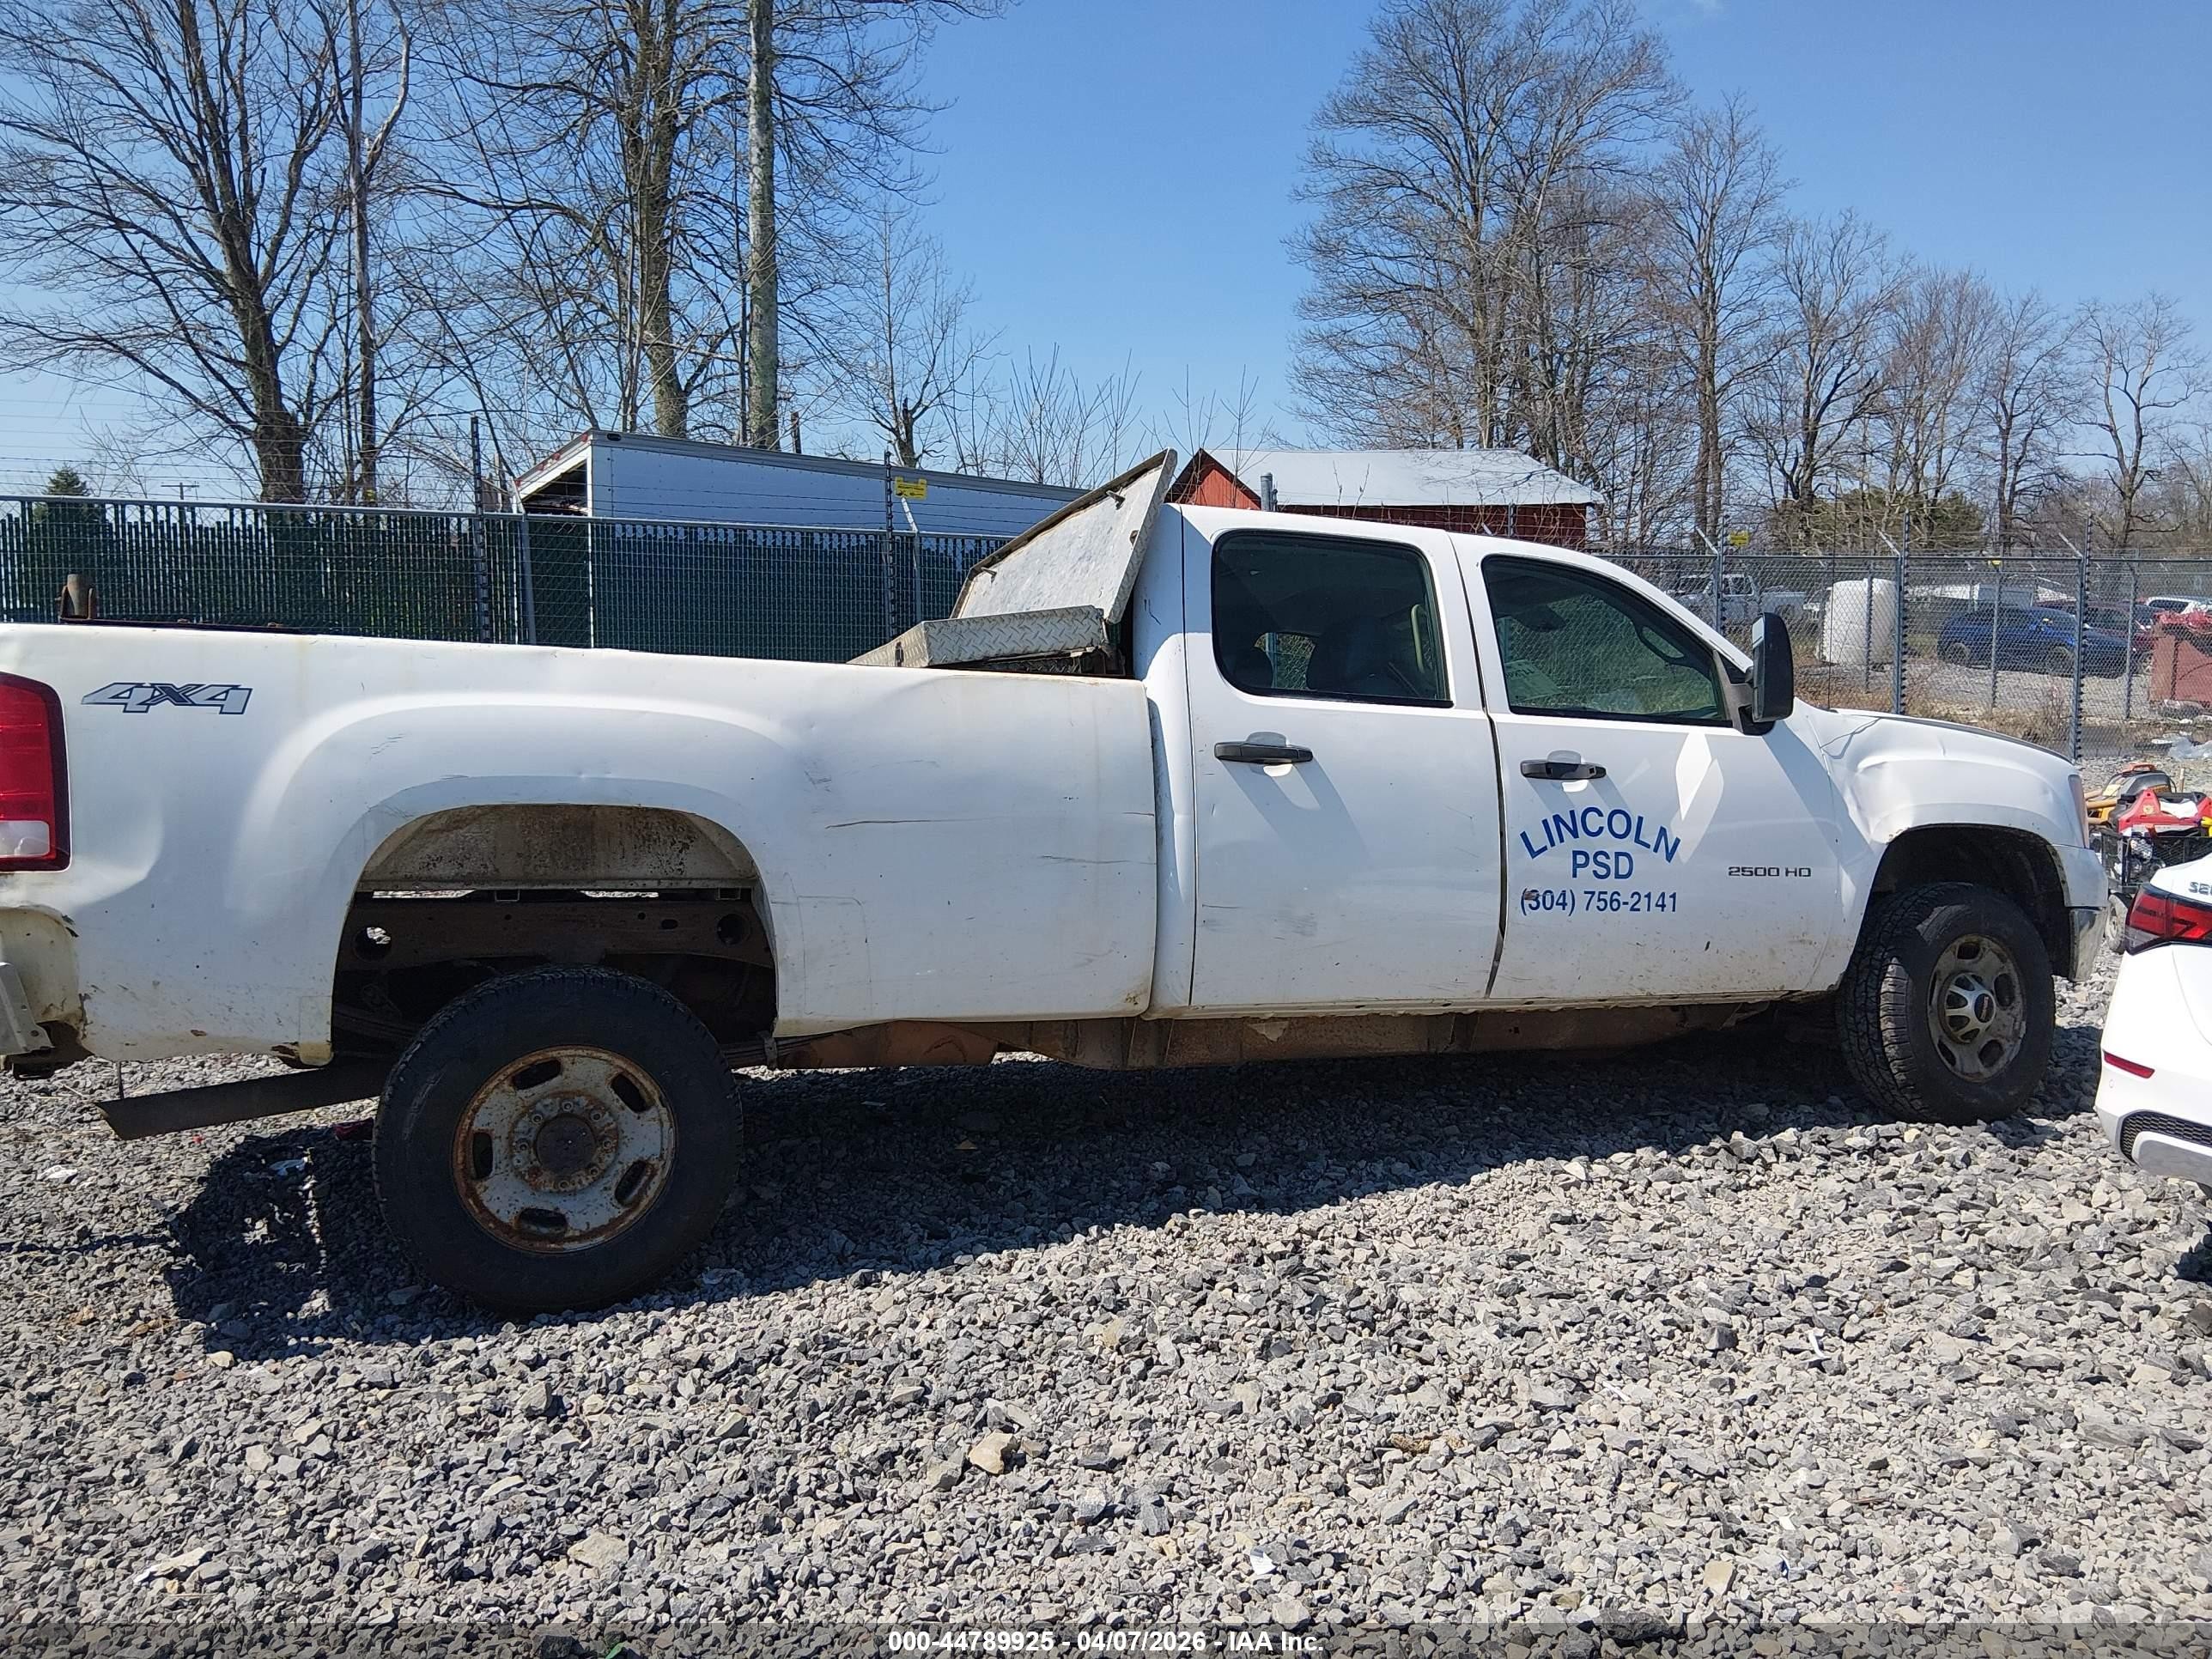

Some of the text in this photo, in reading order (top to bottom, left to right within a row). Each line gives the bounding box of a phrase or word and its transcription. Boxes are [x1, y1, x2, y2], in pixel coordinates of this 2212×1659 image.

[1519, 806, 1681, 864] LINCOLN
[1571, 849, 1634, 879] PSD
[1728, 866, 1812, 877] 2500 HD
[1520, 888, 1677, 916] (304) 756-2141
